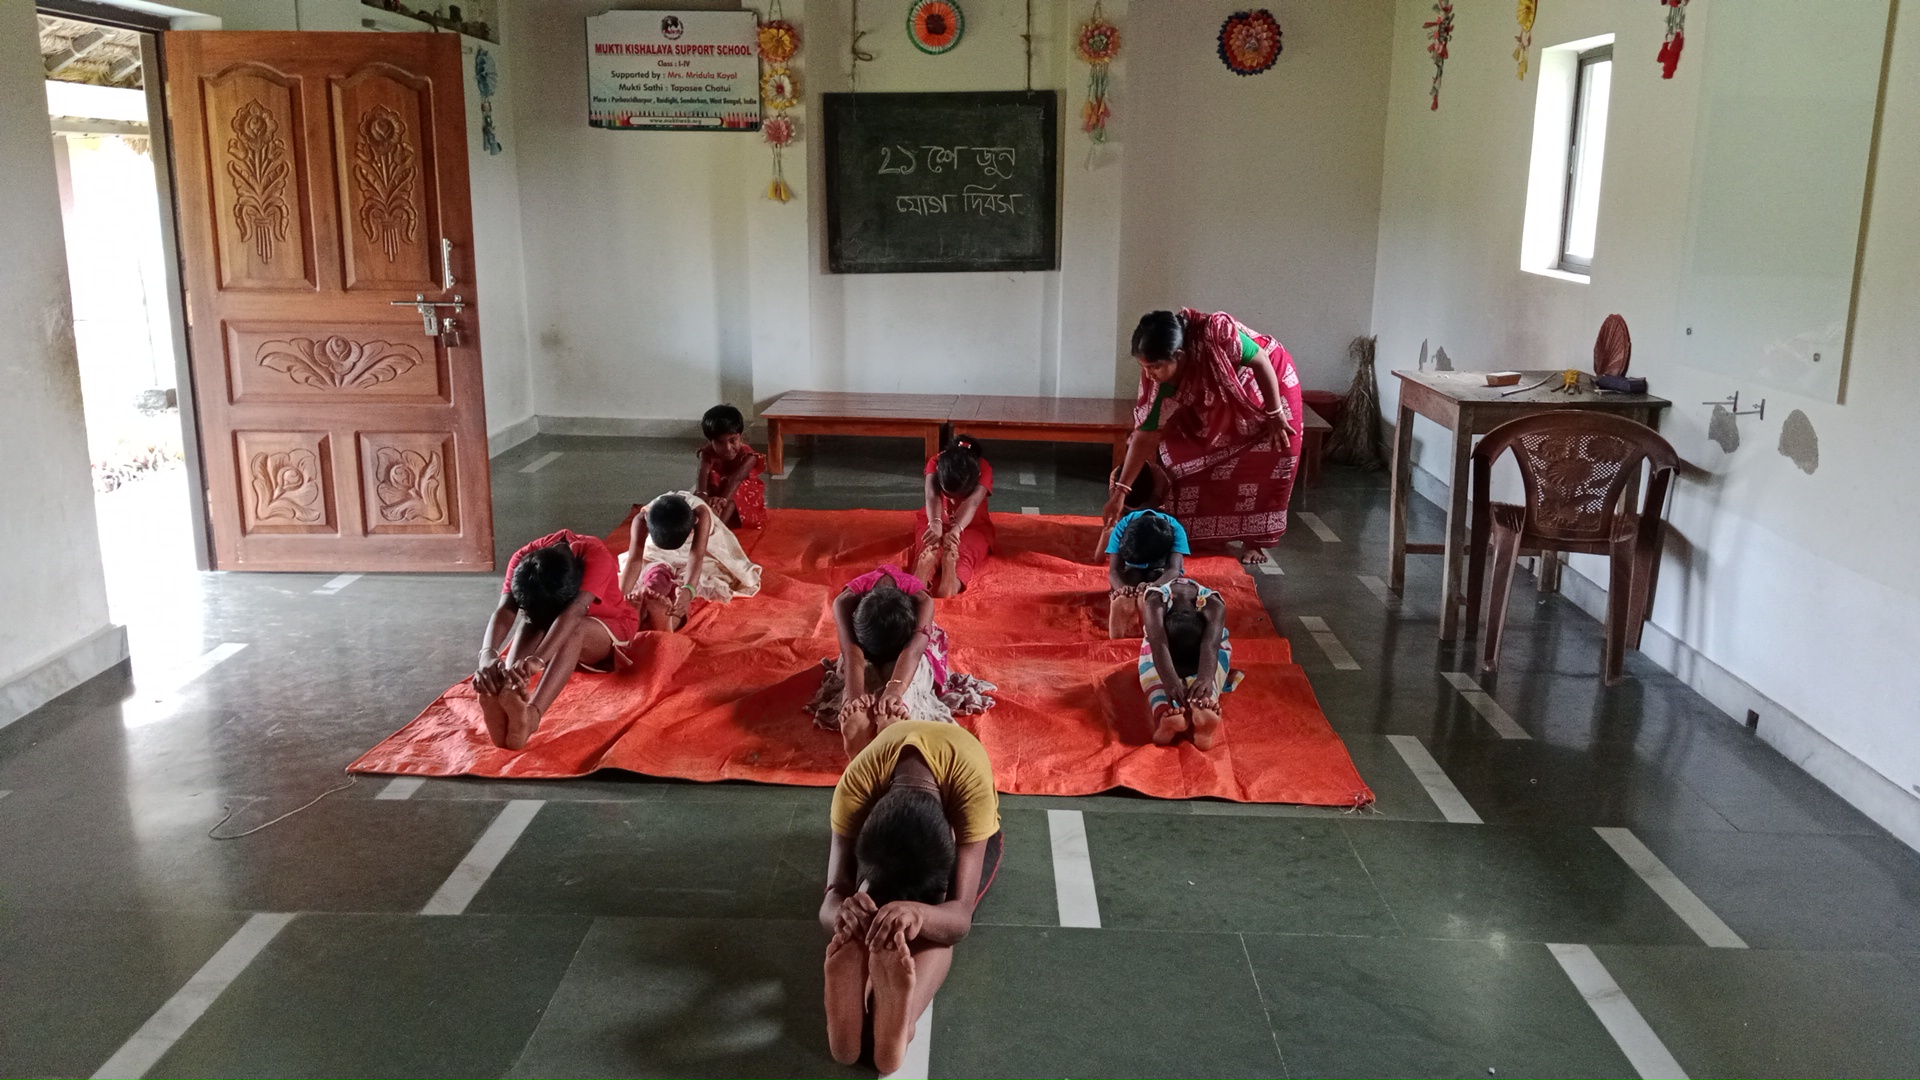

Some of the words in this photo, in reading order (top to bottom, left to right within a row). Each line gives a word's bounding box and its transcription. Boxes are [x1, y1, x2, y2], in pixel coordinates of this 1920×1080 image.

[595, 44, 623, 54] MUKTI
[625, 44, 673, 55] KISHALAYA
[675, 44, 715, 55] SUPPORT
[717, 45, 752, 56] SCHOOL
[611, 70, 650, 79] Supported
[651, 70, 661, 80] by
[667, 71, 684, 79] Mrs.
[686, 71, 715, 79] Mridula
[717, 71, 737, 80] Kayal
[618, 83, 641, 91] Mukti
[643, 83, 663, 91] Sathi
[671, 84, 703, 93] Tapasee
[705, 84, 731, 92] Chatui
[878, 145, 917, 175] ২১
[920, 145, 969, 173] শে
[971, 147, 1016, 180] জুন
[962, 183, 1023, 216] দিবস
